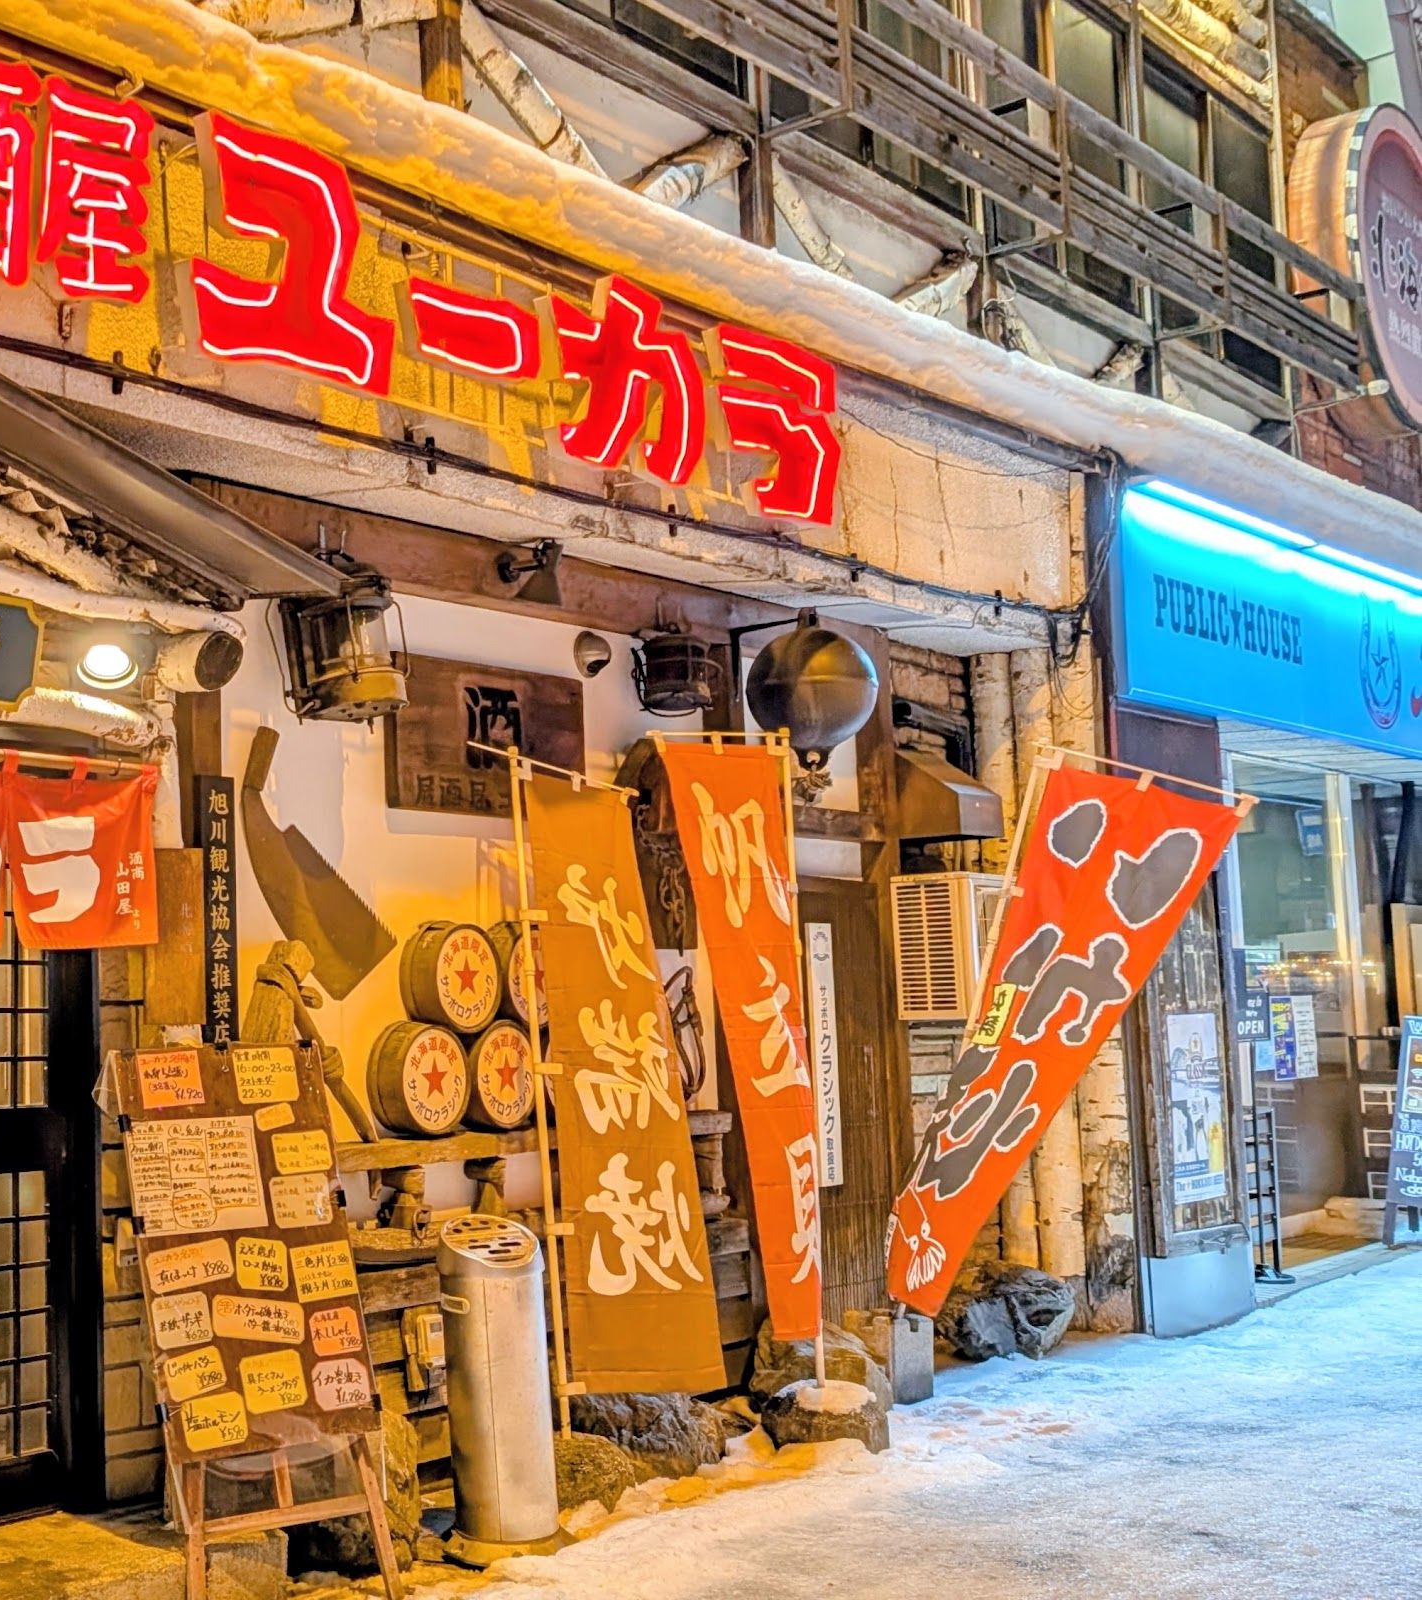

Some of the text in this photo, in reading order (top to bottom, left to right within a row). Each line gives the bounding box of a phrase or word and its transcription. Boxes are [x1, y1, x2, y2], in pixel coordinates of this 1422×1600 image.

[192, 114, 840, 524] ユーカラ
[1153, 573, 1303, 666] PUBLIC HOUSE
[115, 861, 133, 916] 山田屋
[208, 788, 232, 1044] 旭川観光協会推奨店
[1238, 1020, 1265, 1036] OPEN
